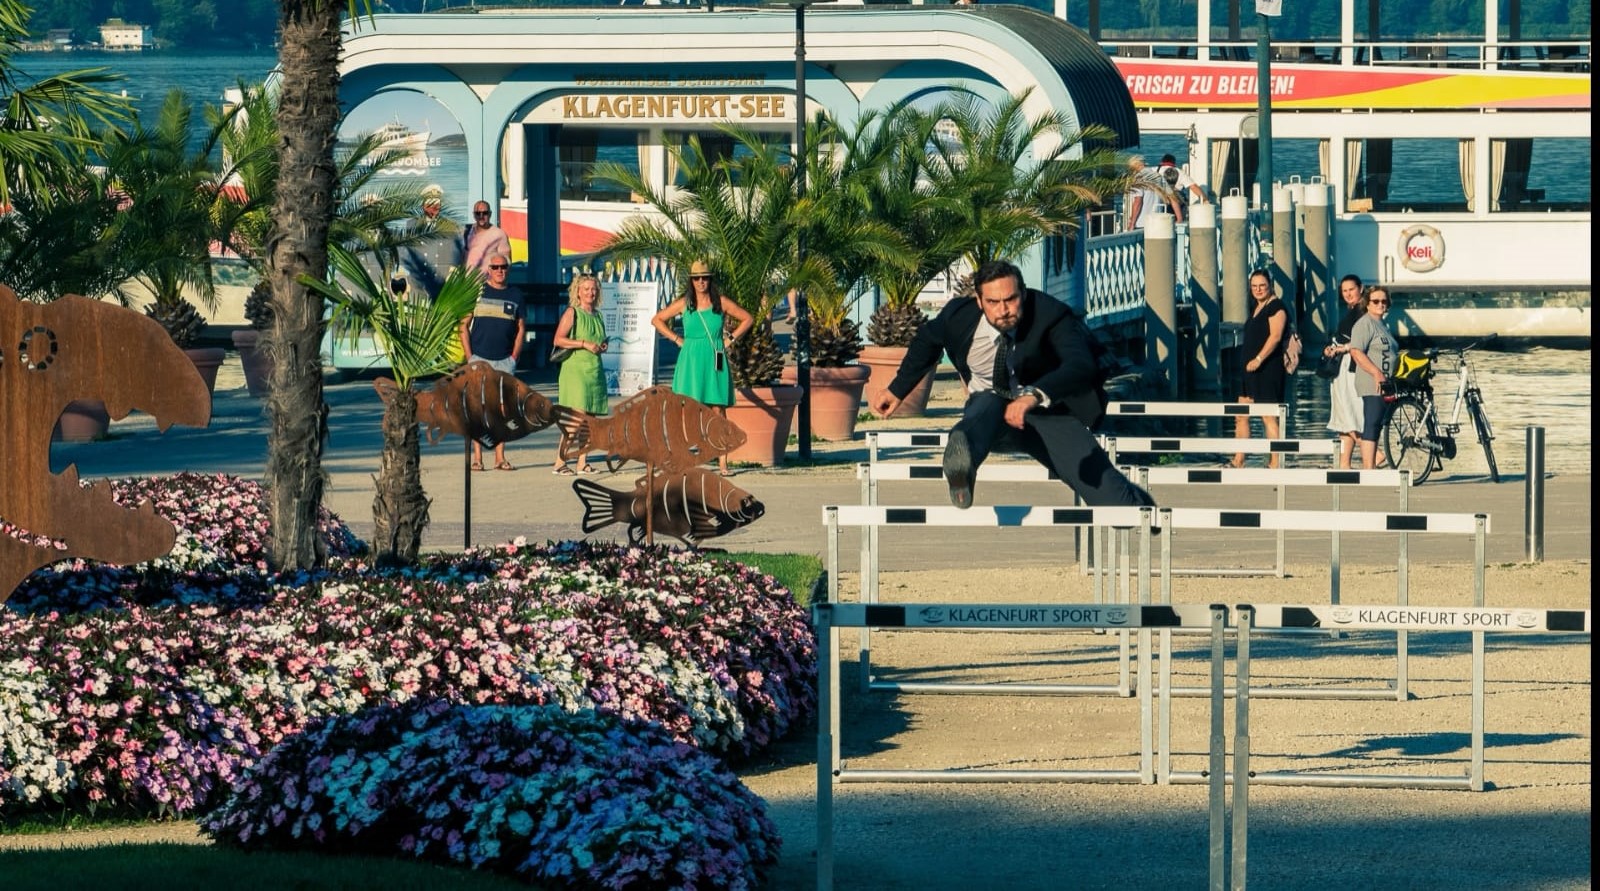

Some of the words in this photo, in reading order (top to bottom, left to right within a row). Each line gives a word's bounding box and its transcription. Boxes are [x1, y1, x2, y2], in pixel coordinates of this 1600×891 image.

[1126, 75, 1186, 95] FRISCH
[1188, 75, 1214, 95] ZU
[563, 95, 785, 118] KLAGENFURT-SEE
[1408, 246, 1432, 258] Keli
[950, 609, 1048, 622] KLAGENFURT
[1052, 609, 1102, 623] SPORT
[1359, 610, 1457, 625] KLAGENFURT
[1463, 612, 1511, 626] SPORT
